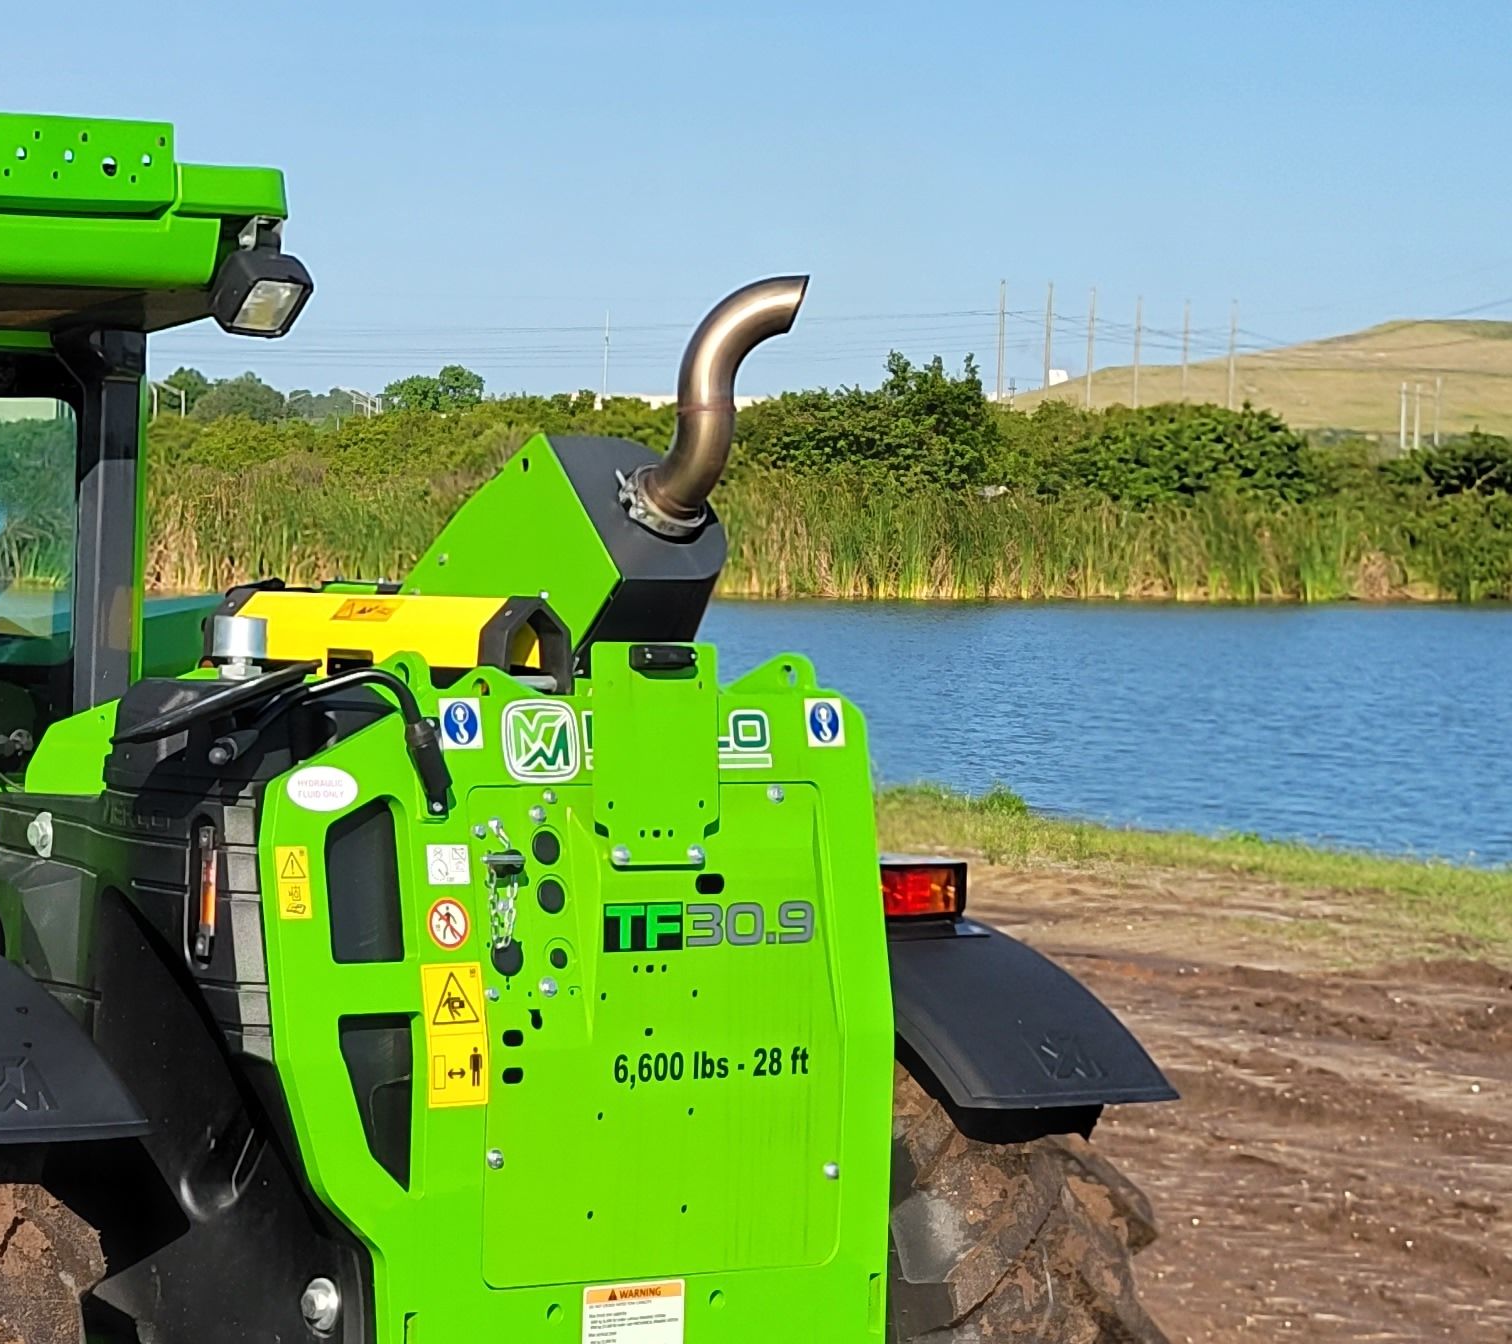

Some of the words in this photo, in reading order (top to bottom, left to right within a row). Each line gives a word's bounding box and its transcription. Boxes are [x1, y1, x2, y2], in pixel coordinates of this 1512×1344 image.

[297, 779, 344, 788] HYDRAULIC
[297, 790, 321, 798] FLUID
[322, 790, 345, 798] ONLY
[604, 901, 815, 952] TF30.9
[614, 1051, 685, 1090] 6,600
[692, 1051, 729, 1079] lbs
[752, 1047, 783, 1076] 28
[790, 1046, 810, 1075] ft
[619, 1287, 661, 1299] WARNING
